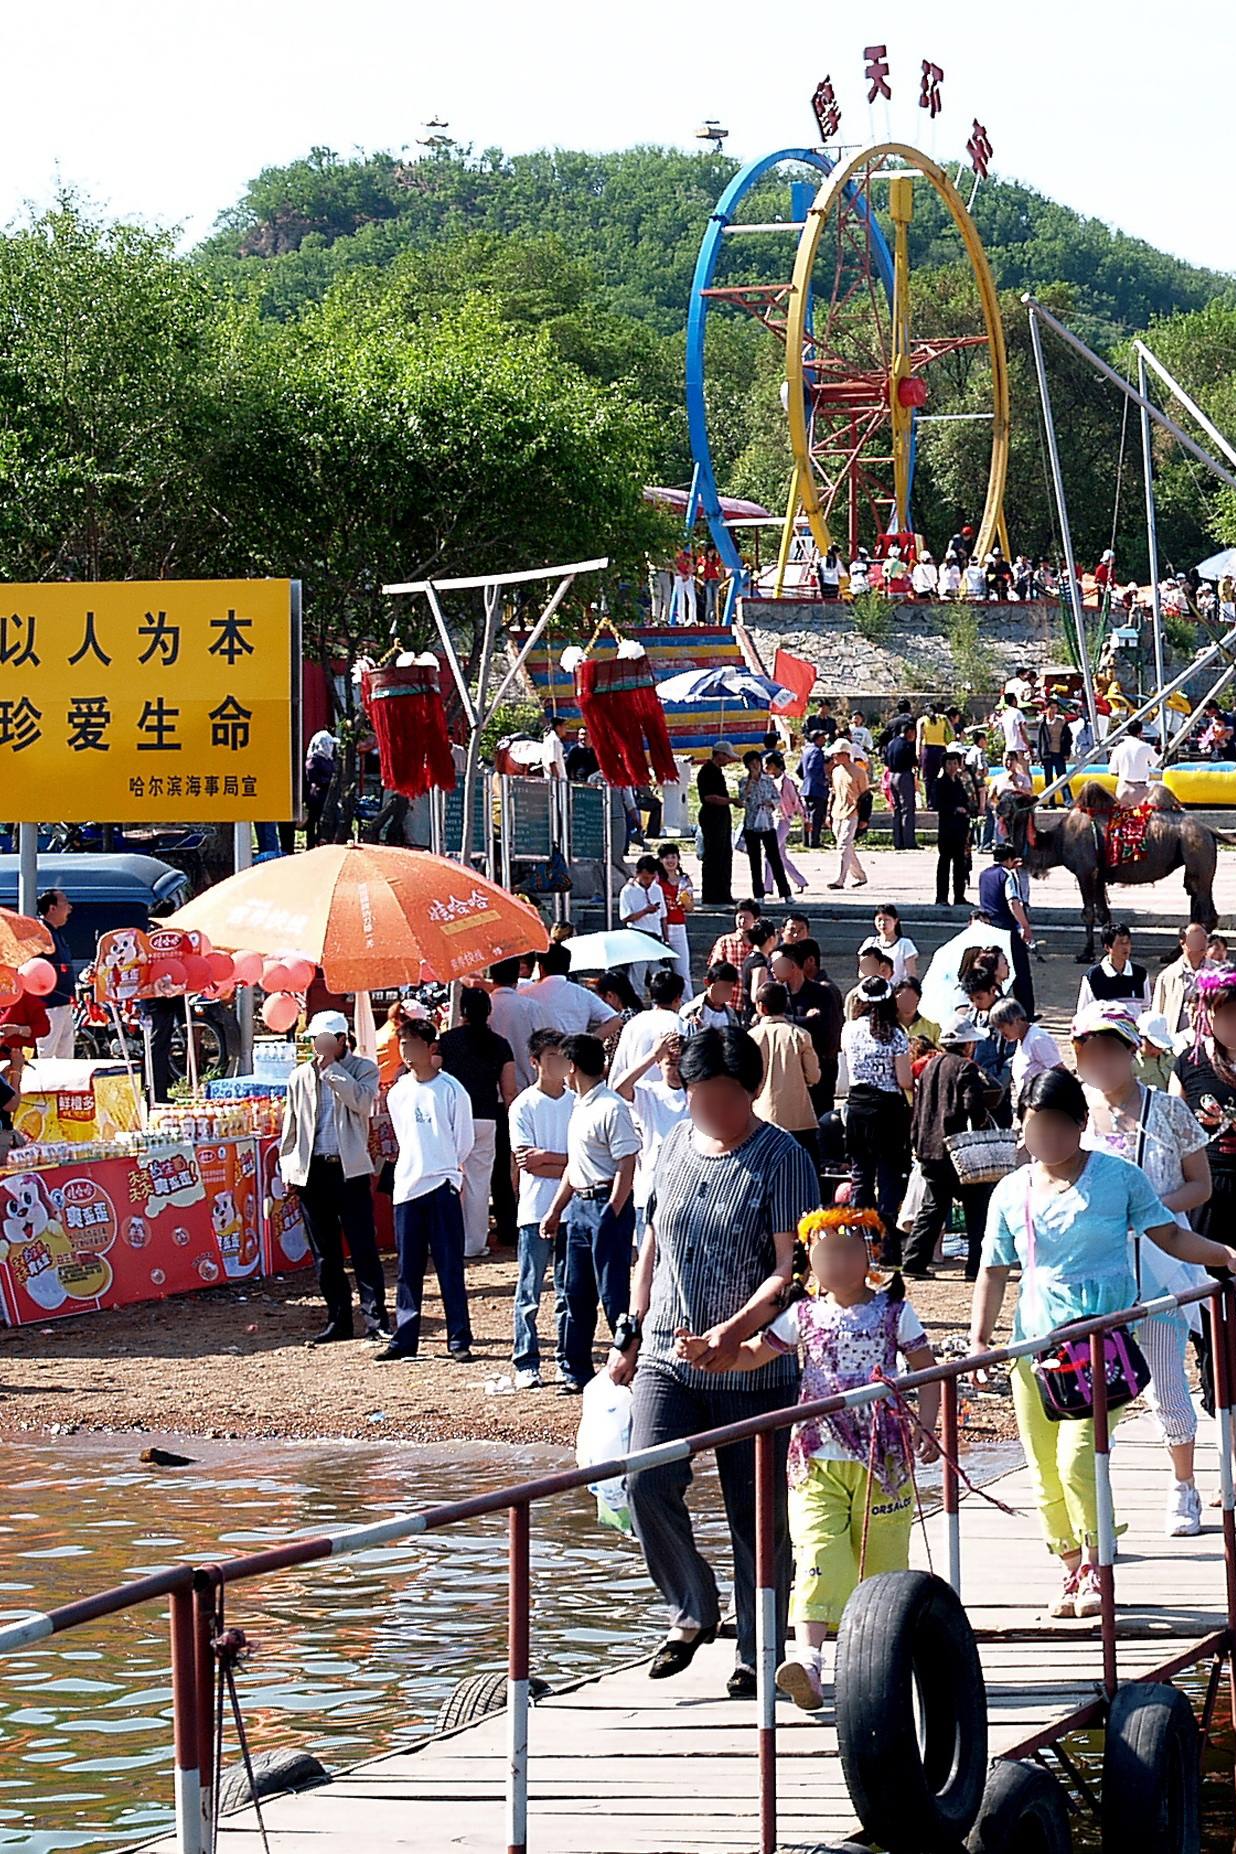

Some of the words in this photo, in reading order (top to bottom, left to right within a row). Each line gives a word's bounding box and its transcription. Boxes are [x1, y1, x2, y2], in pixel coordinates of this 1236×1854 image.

[0, 610, 254, 667] 以人为本
[0, 695, 252, 751] 珍爱生命
[129, 776, 258, 797] 哈尔滨海事局宣
[427, 889, 489, 921] 娃哈哈
[58, 1095, 95, 1111] 鲜橙多
